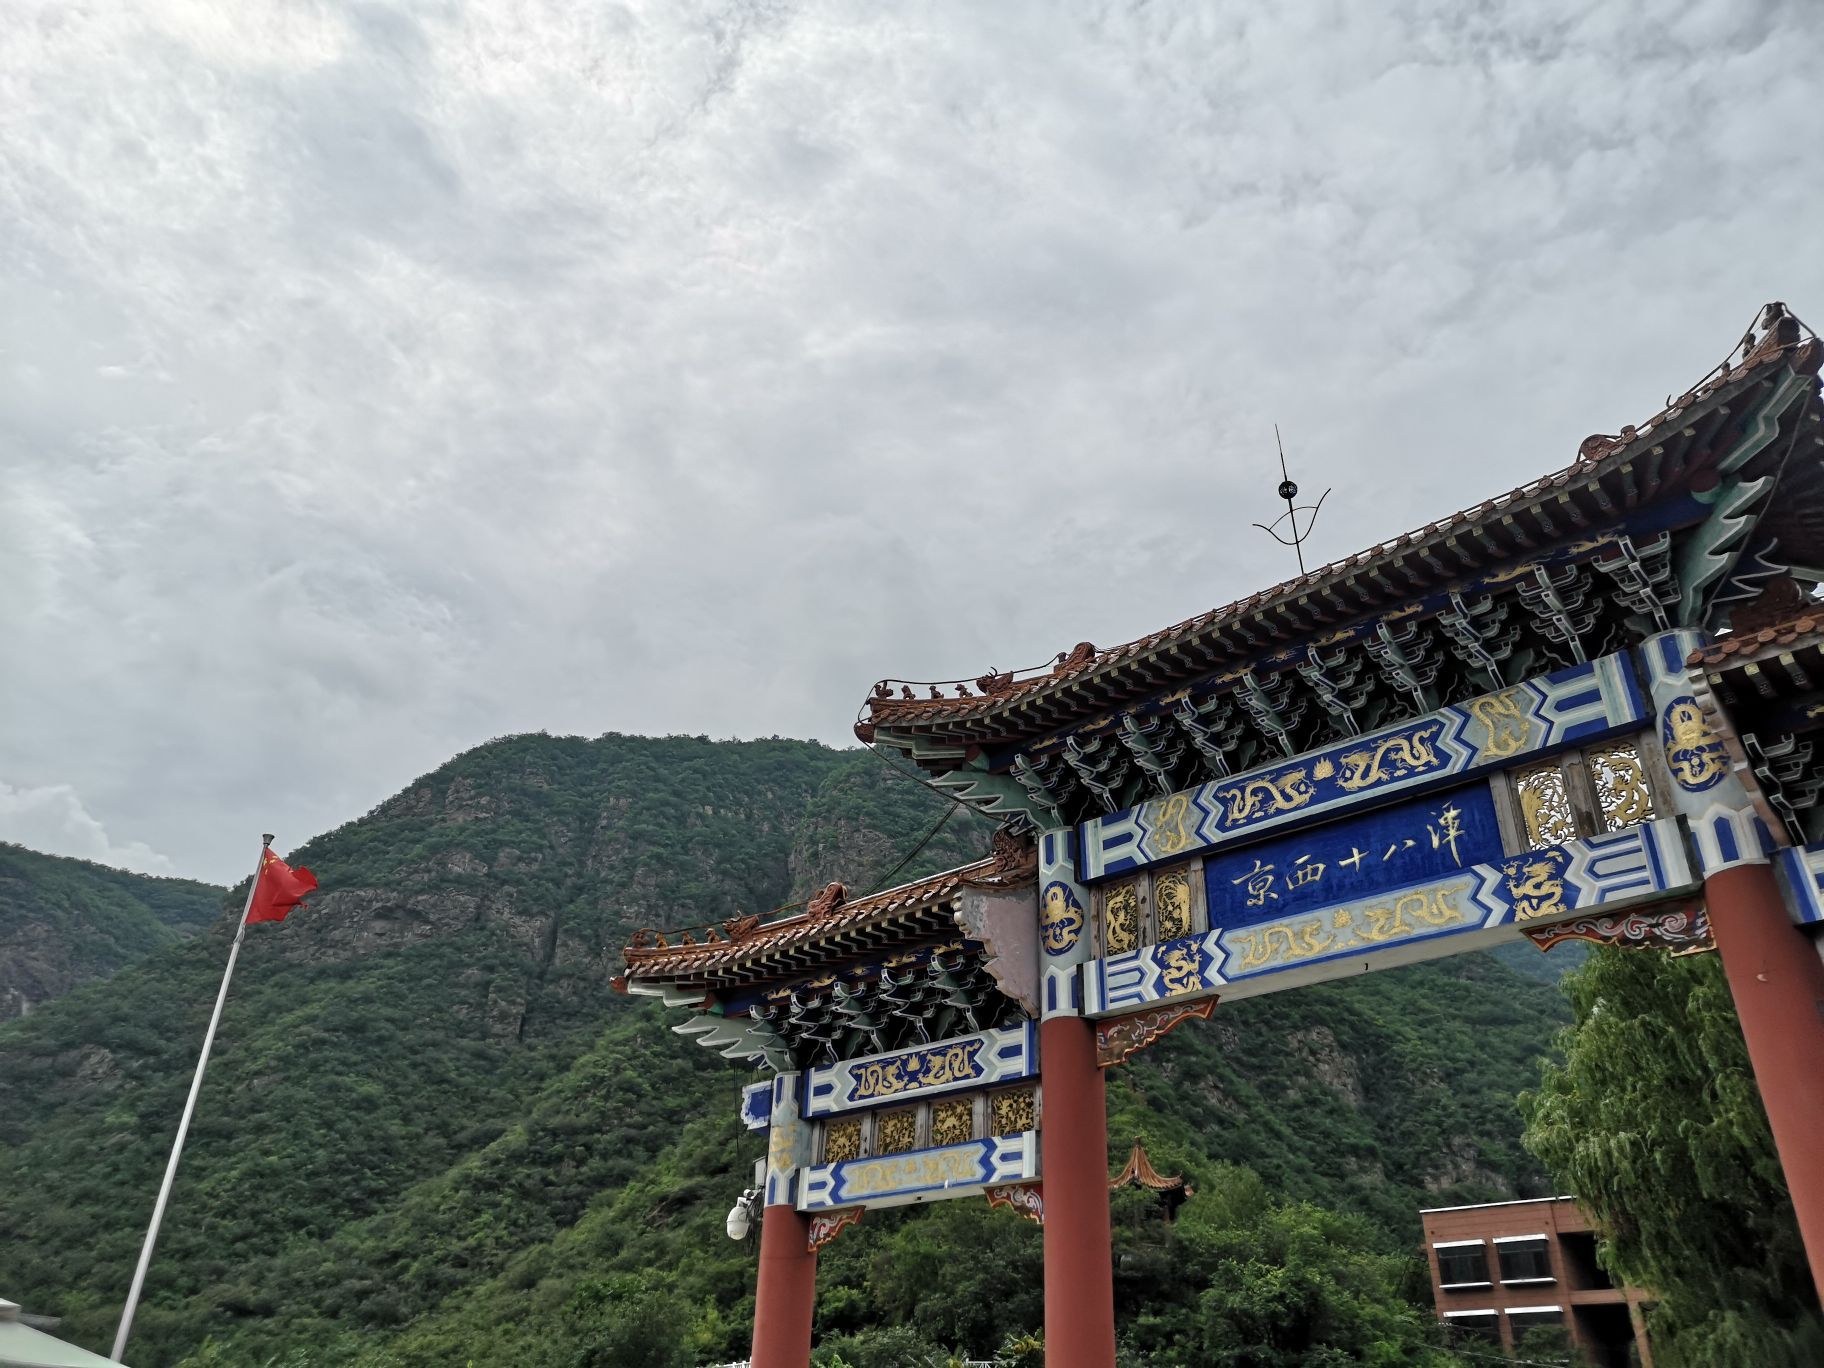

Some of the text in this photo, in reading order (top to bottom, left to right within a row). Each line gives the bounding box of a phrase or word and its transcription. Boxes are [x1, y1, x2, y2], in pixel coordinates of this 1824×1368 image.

[1231, 802, 1465, 907] 京西十八潭
